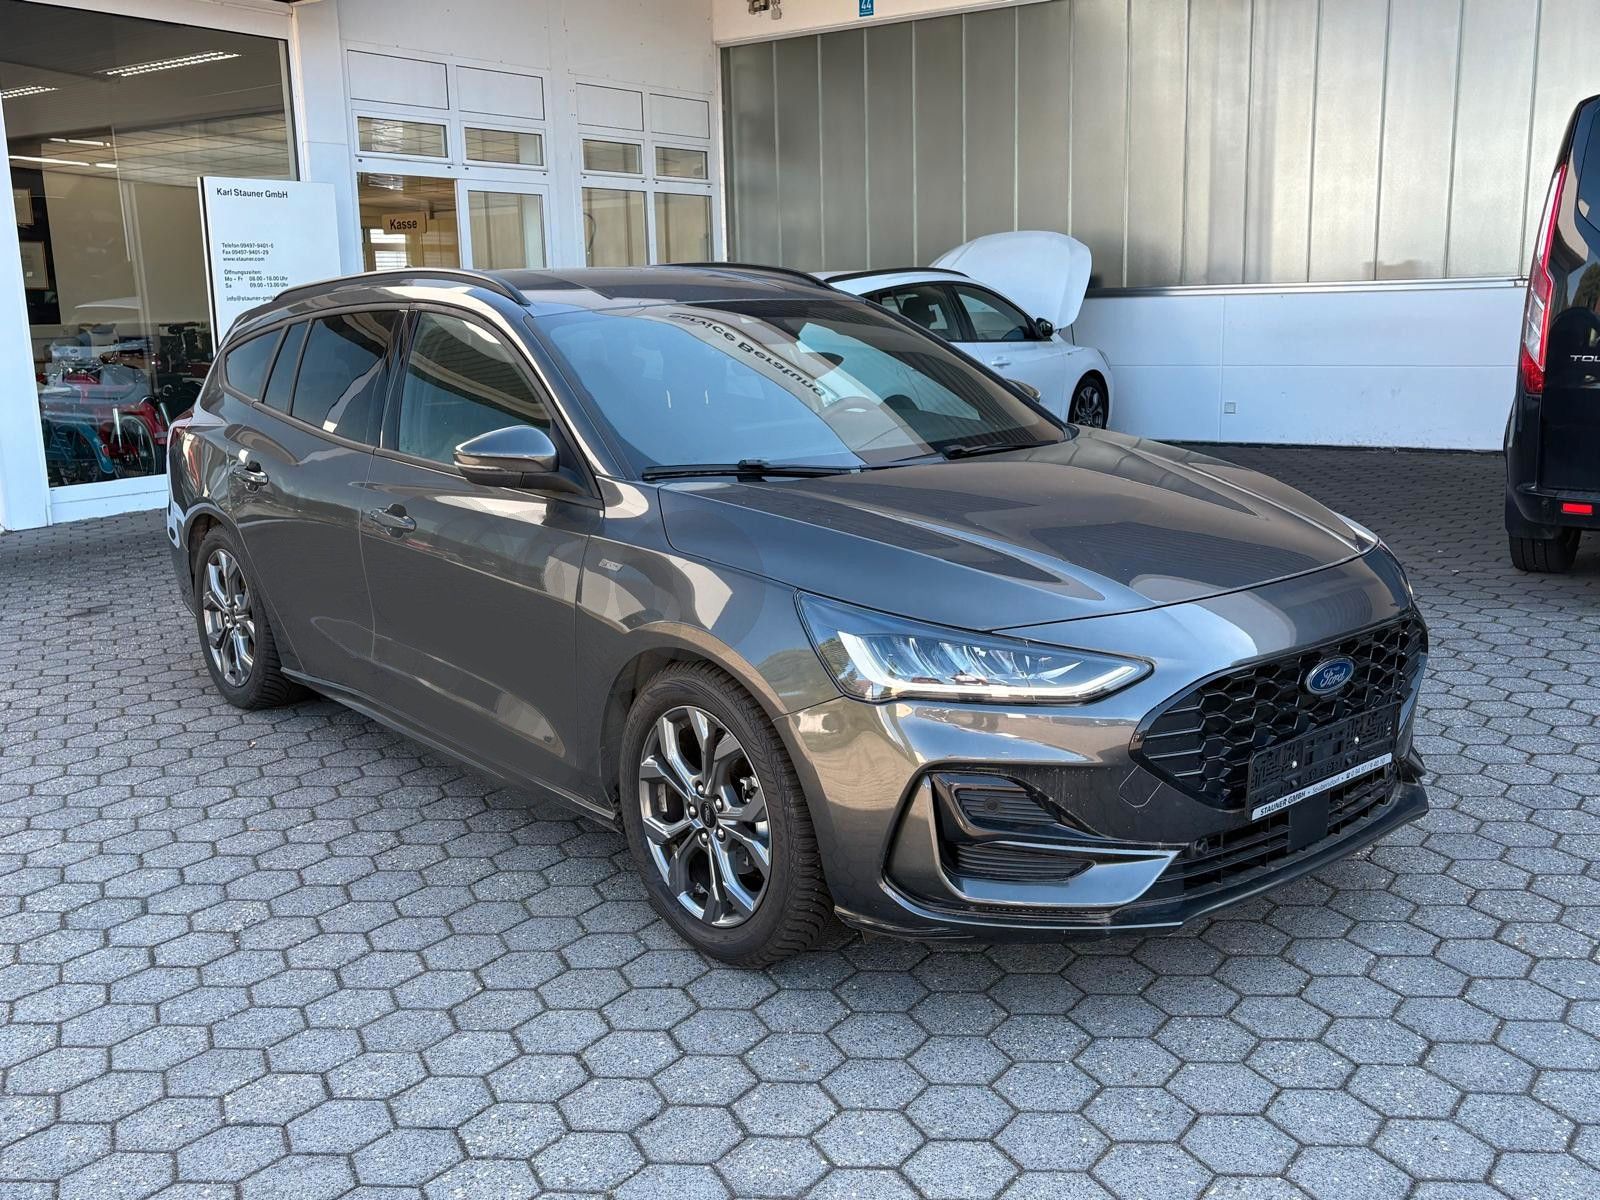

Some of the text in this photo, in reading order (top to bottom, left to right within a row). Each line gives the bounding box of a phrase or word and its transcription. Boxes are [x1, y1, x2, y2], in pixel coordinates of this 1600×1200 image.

[216, 187, 288, 198] Karl Stauner GmbH
[390, 219, 417, 230] Kasse
[223, 268, 262, 276] Öffnungszeiten:
[1320, 666, 1346, 687] Ford
[1260, 798, 1287, 816] STAUNER
